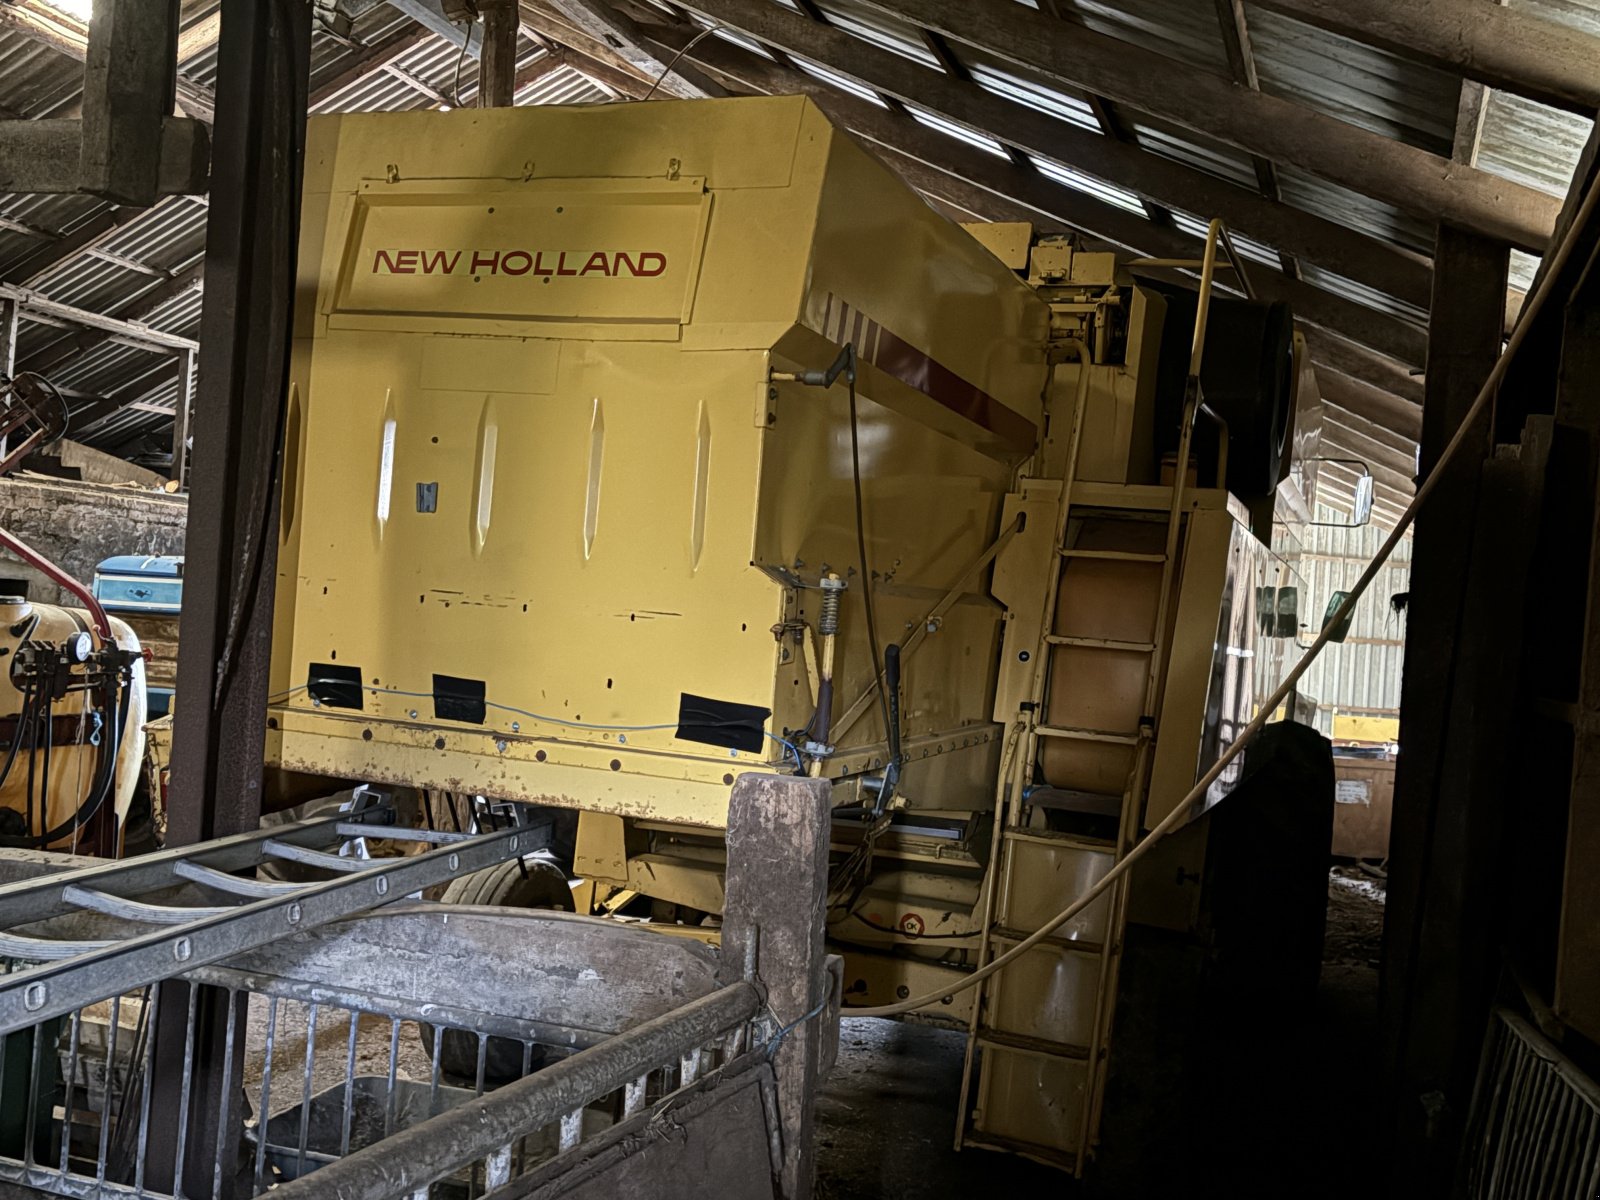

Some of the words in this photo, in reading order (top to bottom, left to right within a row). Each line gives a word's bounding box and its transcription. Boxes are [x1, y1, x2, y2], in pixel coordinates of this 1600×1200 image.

[372, 251, 462, 274] NEW
[470, 251, 667, 277] HOLLAND
[906, 922, 918, 931] OK
